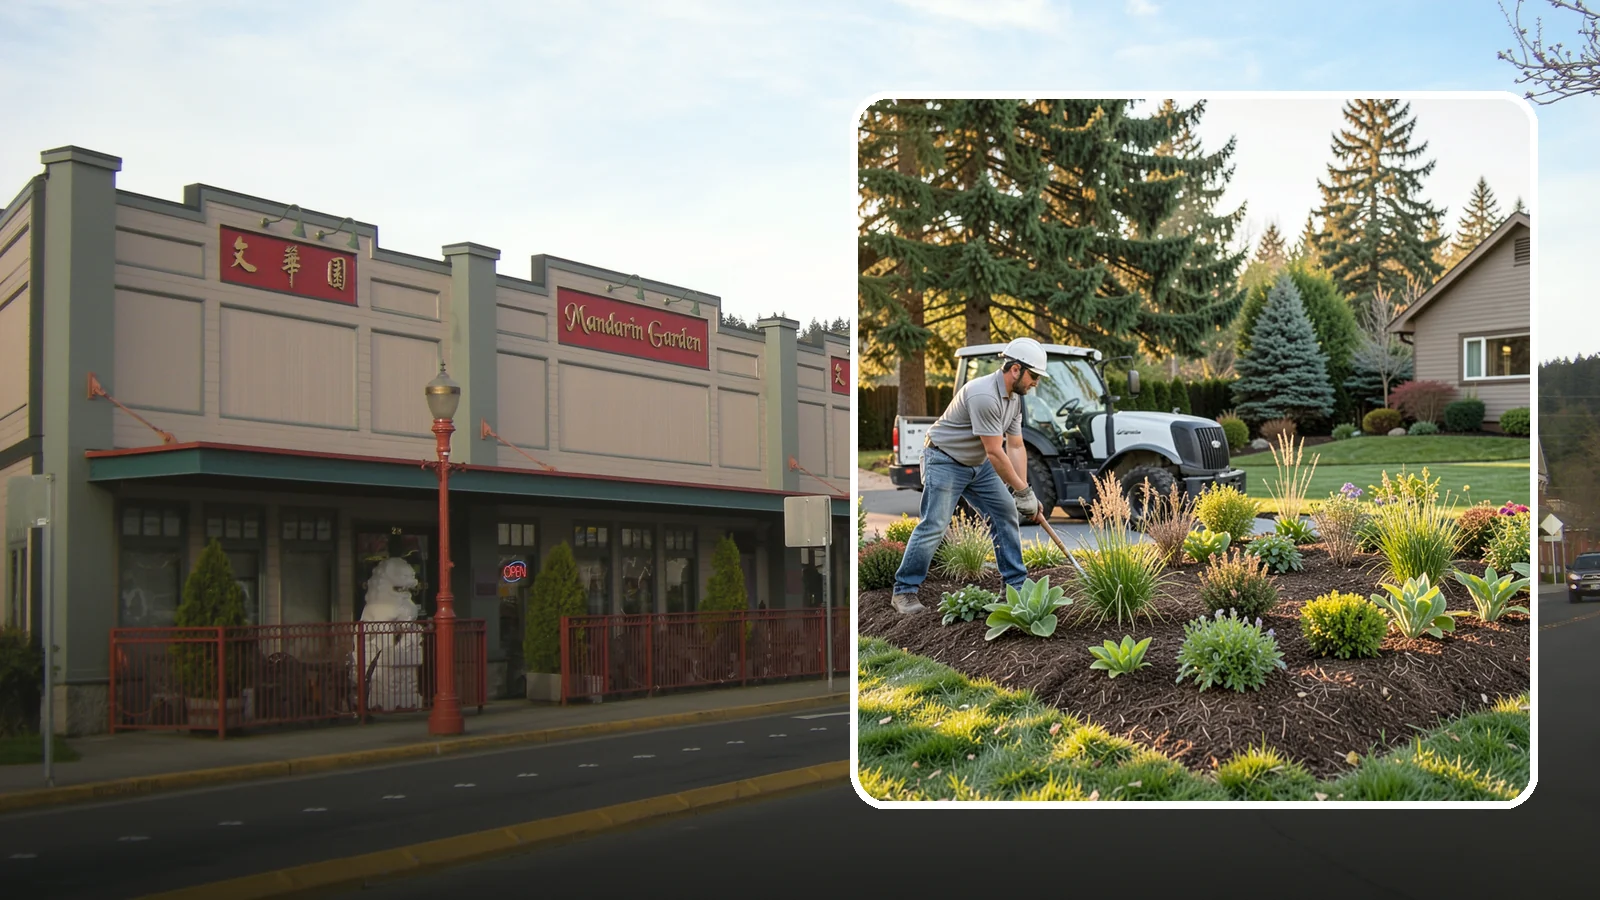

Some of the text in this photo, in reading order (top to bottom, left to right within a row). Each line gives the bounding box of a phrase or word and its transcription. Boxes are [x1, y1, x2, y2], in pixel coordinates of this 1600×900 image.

[230, 235, 346, 291] 文華園
[564, 302, 702, 352] Mandarin Garden
[503, 565, 527, 578] OPEN
